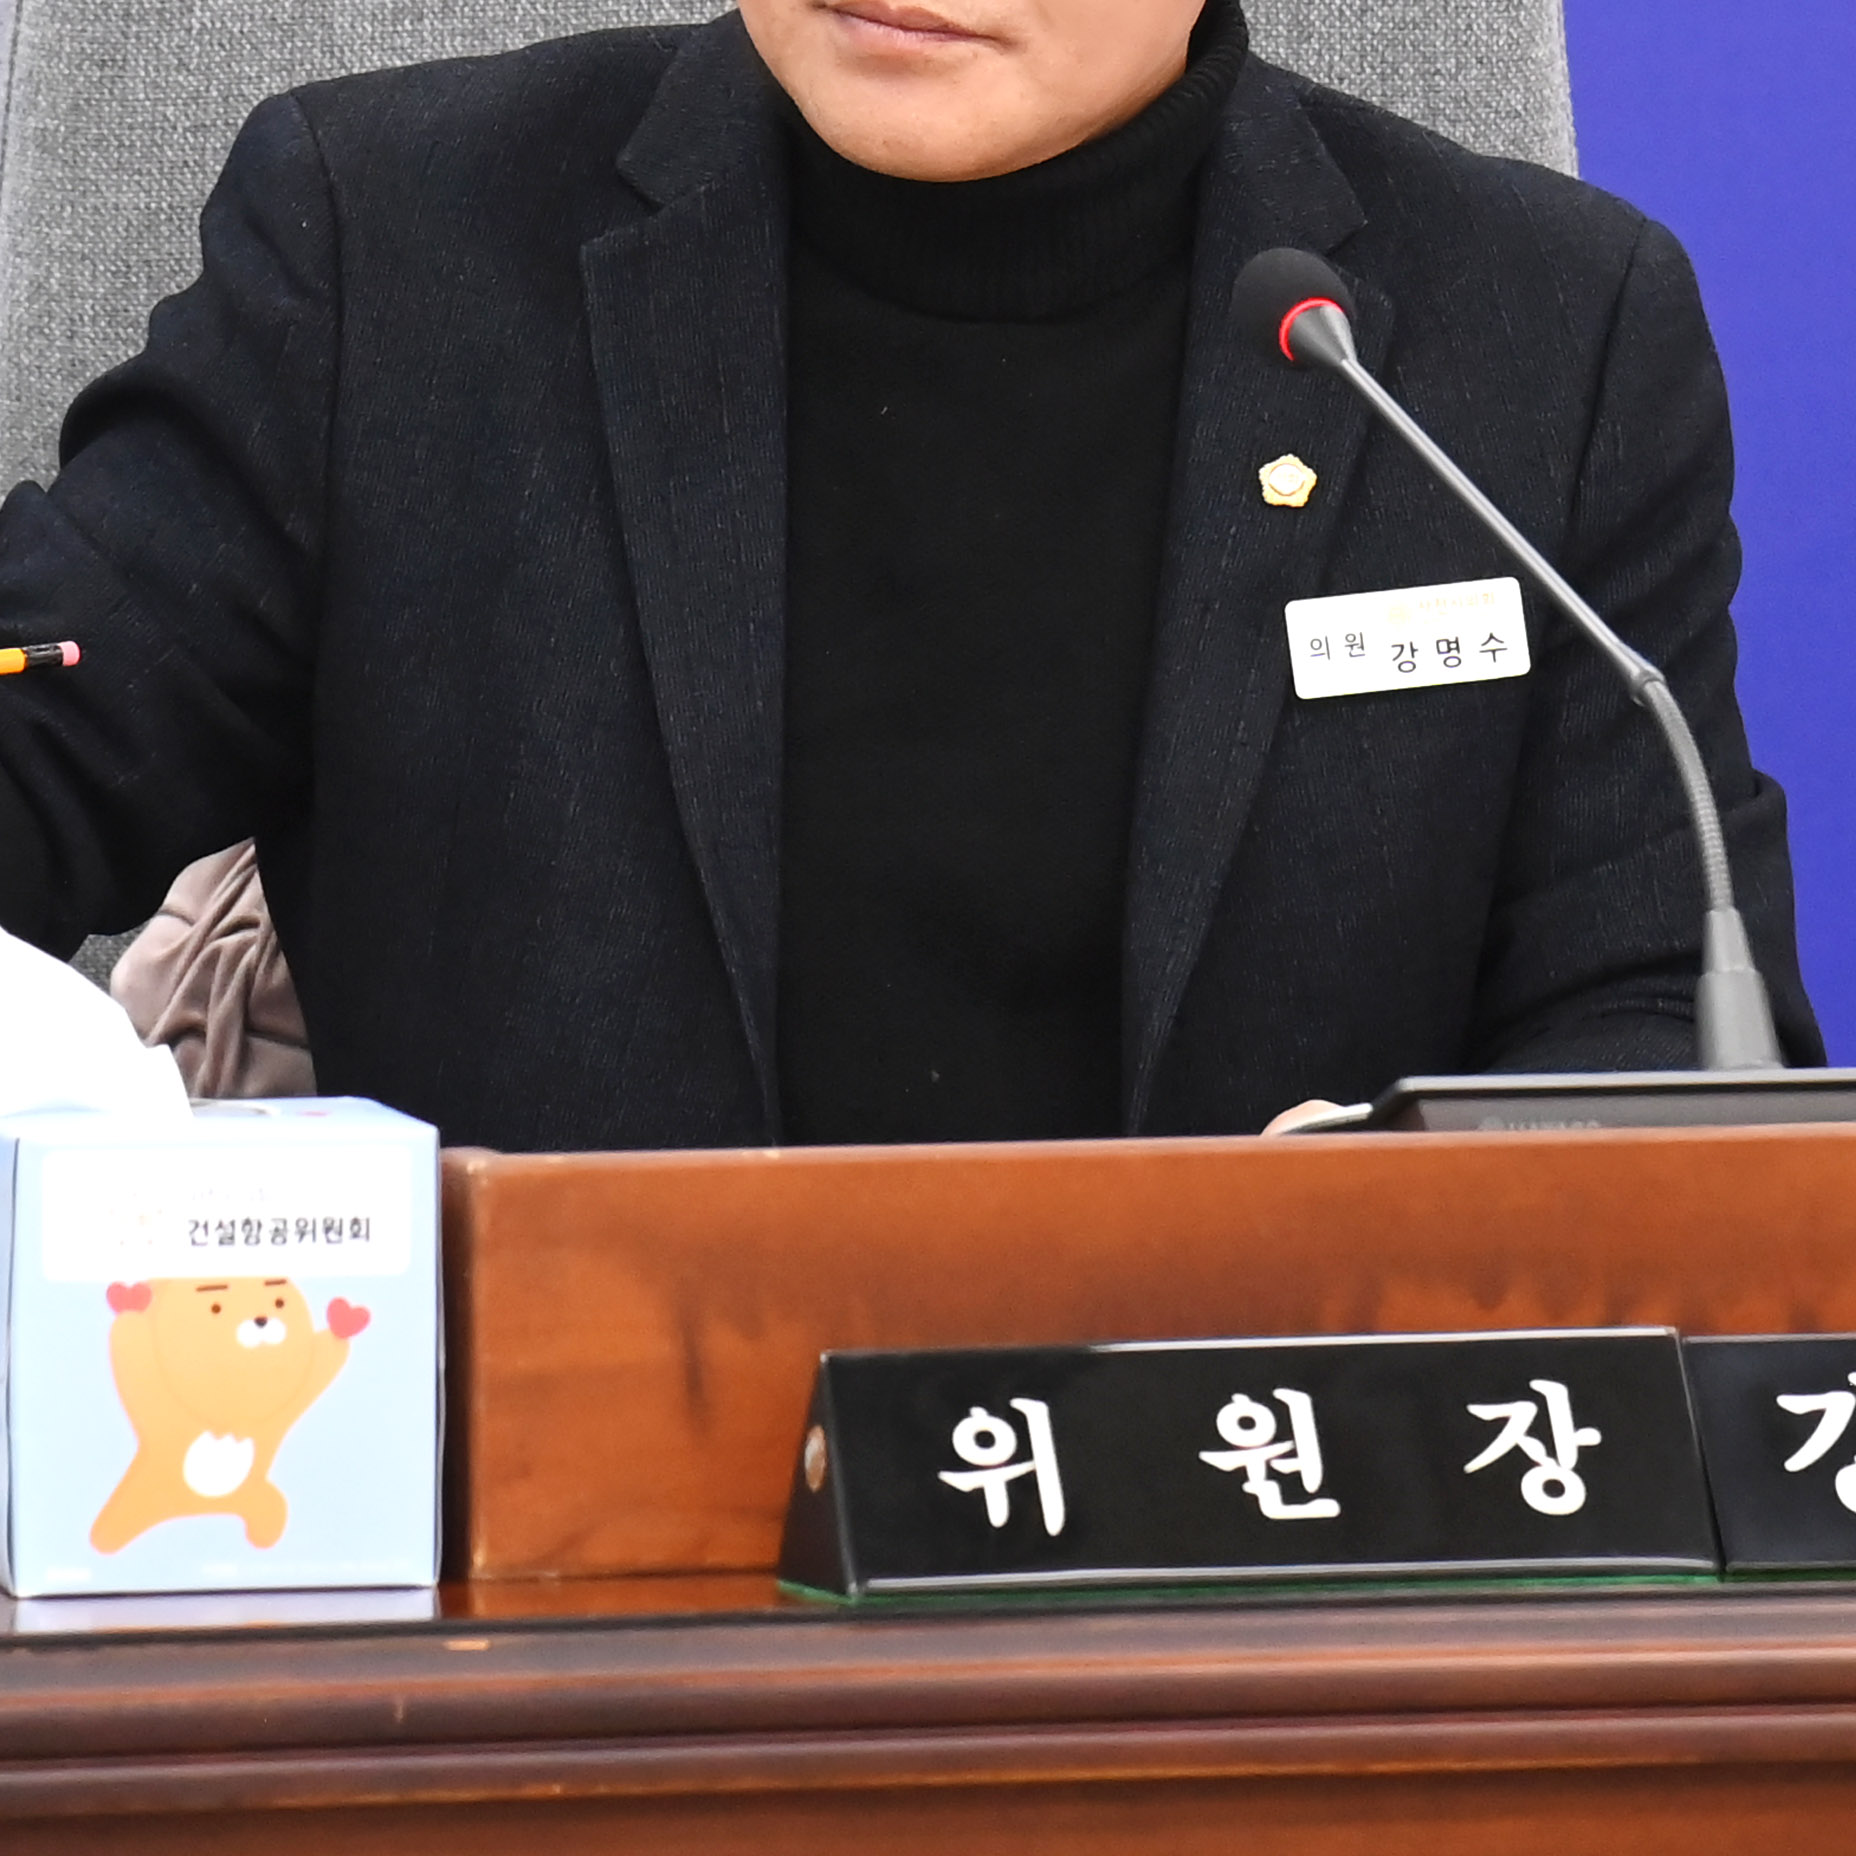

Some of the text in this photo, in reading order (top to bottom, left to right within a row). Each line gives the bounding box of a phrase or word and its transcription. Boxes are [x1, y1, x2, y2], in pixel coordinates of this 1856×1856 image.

[1310, 632, 1508, 674] 의원 강명수
[188, 1217, 371, 1247] 건설항공위원회
